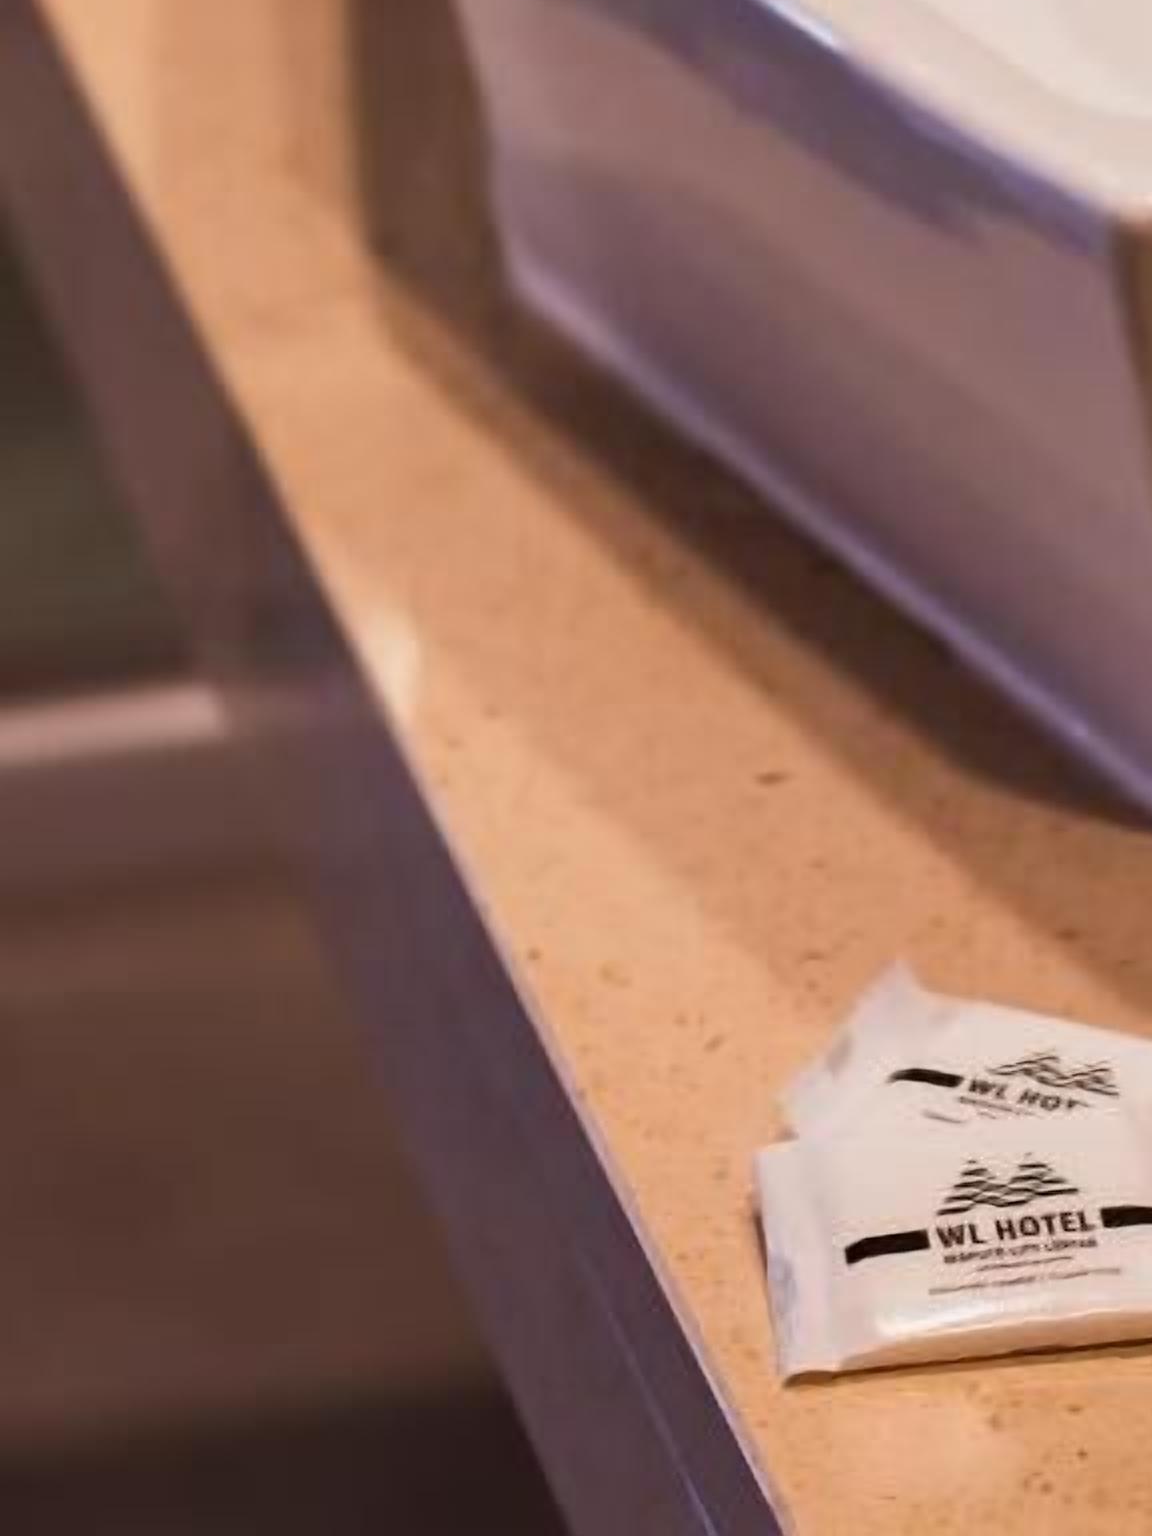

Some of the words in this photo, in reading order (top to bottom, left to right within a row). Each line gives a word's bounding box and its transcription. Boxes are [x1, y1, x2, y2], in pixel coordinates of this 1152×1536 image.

[968, 1078, 1009, 1101] WL
[936, 1223, 986, 1249] WL
[994, 1210, 1096, 1241] HOTEL
